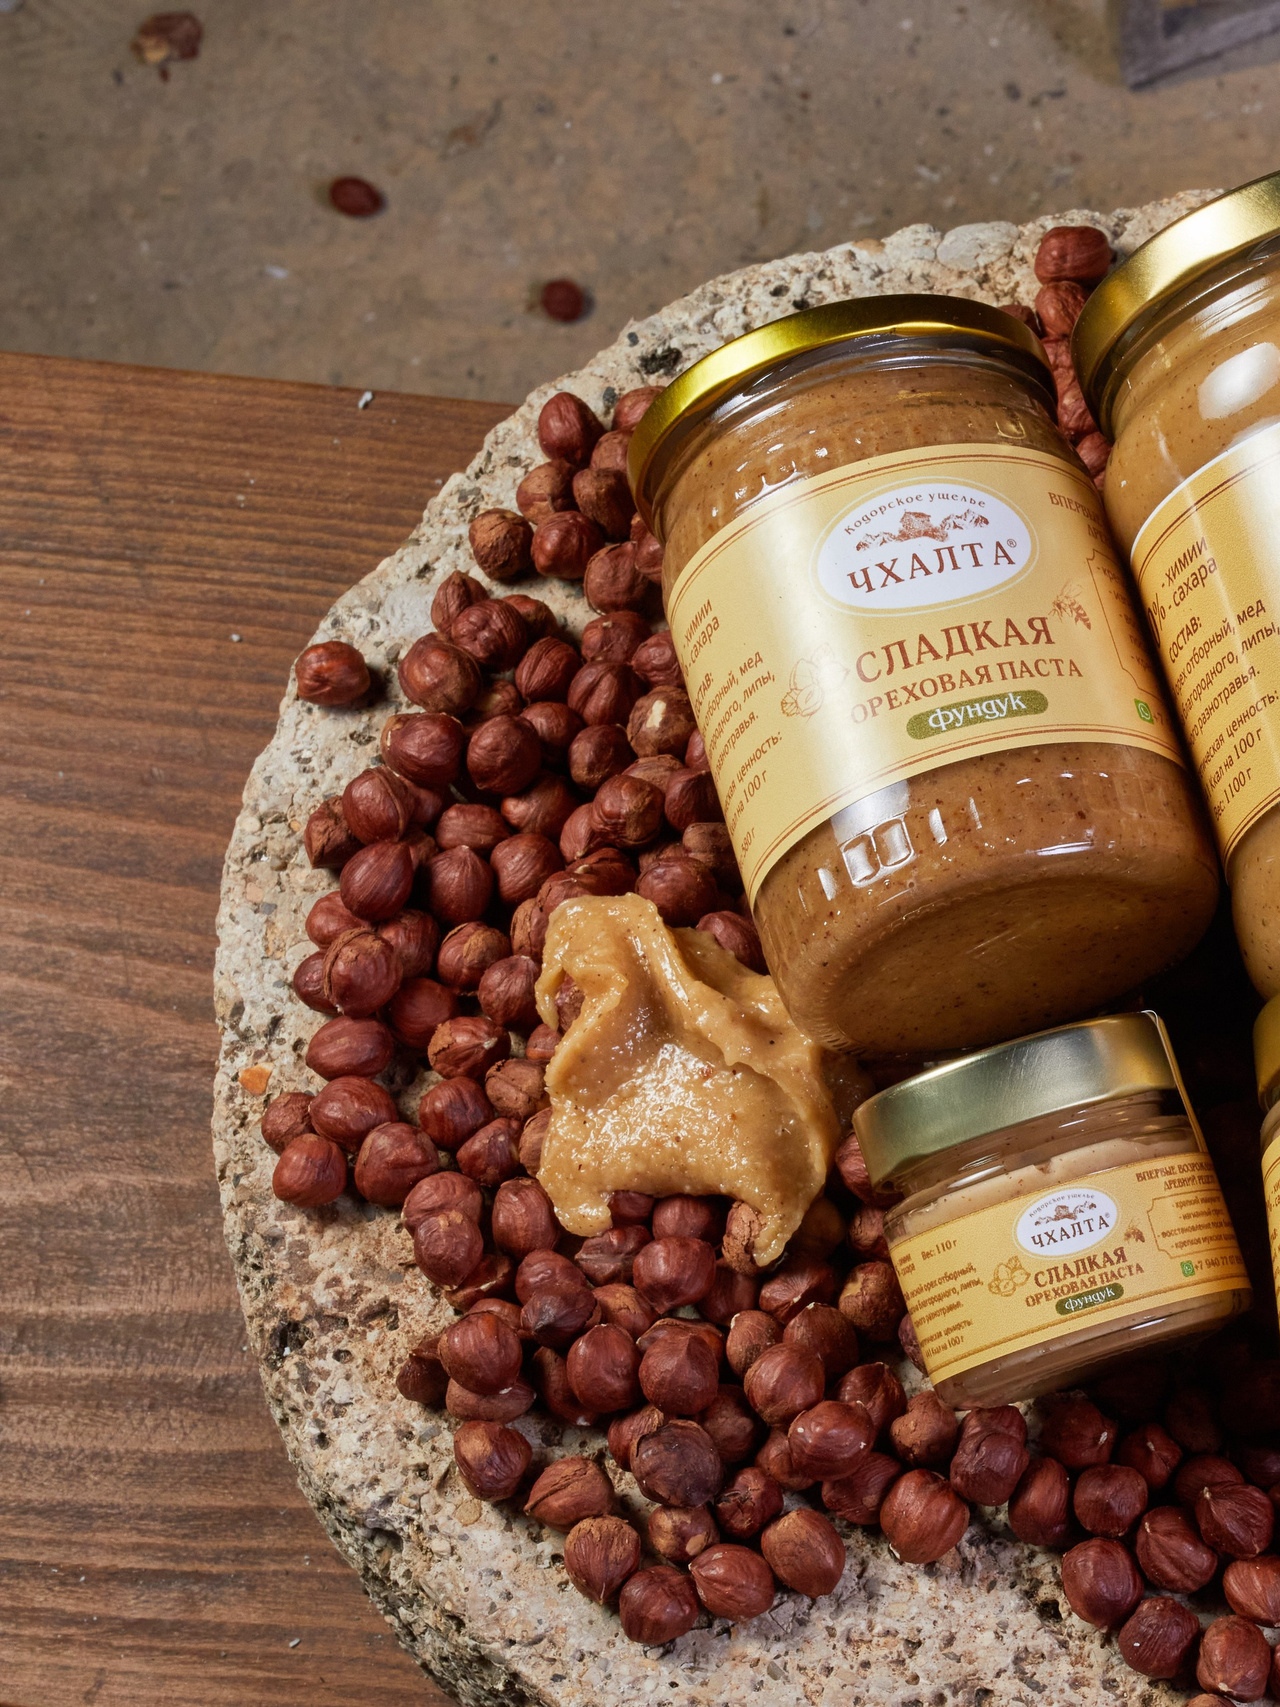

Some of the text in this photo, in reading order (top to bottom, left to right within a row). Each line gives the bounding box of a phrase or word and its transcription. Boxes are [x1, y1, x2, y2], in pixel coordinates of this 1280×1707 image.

[844, 494, 924, 535] Кодорское
[1165, 536, 1208, 587] химии
[1172, 557, 1218, 607] сахара
[690, 616, 720, 664] сахара
[856, 616, 1055, 683] СЛАДКАЯ
[1169, 616, 1202, 664] СОСТАВ:
[1186, 617, 1236, 675] отборный,
[1236, 599, 1266, 625] мед
[1241, 622, 1280, 655] липы,
[739, 651, 764, 676] мед
[743, 670, 775, 703] липы,
[851, 658, 1083, 724] ОРЕХОВАЯ ПАСТА
[1197, 666, 1260, 735] разнотравья.
[928, 692, 1027, 731] фундук
[1226, 690, 1280, 738] ценность:
[736, 731, 782, 783] ценность:
[1224, 755, 1234, 771] на
[1234, 732, 1255, 760] 100
[1256, 728, 1262, 741] г
[743, 774, 761, 803] 100
[1224, 771, 1247, 805] 1100
[1135, 1165, 1177, 1182] ВПЕРВЫЕ
[935, 1240, 952, 1254] 110
[1034, 1246, 1128, 1288] СЛАДКАЯ
[1025, 1262, 1144, 1307] ОРЕХОВАЯ ПАСТА
[1064, 1286, 1115, 1312] фундук
[947, 1335, 960, 1348] 100
